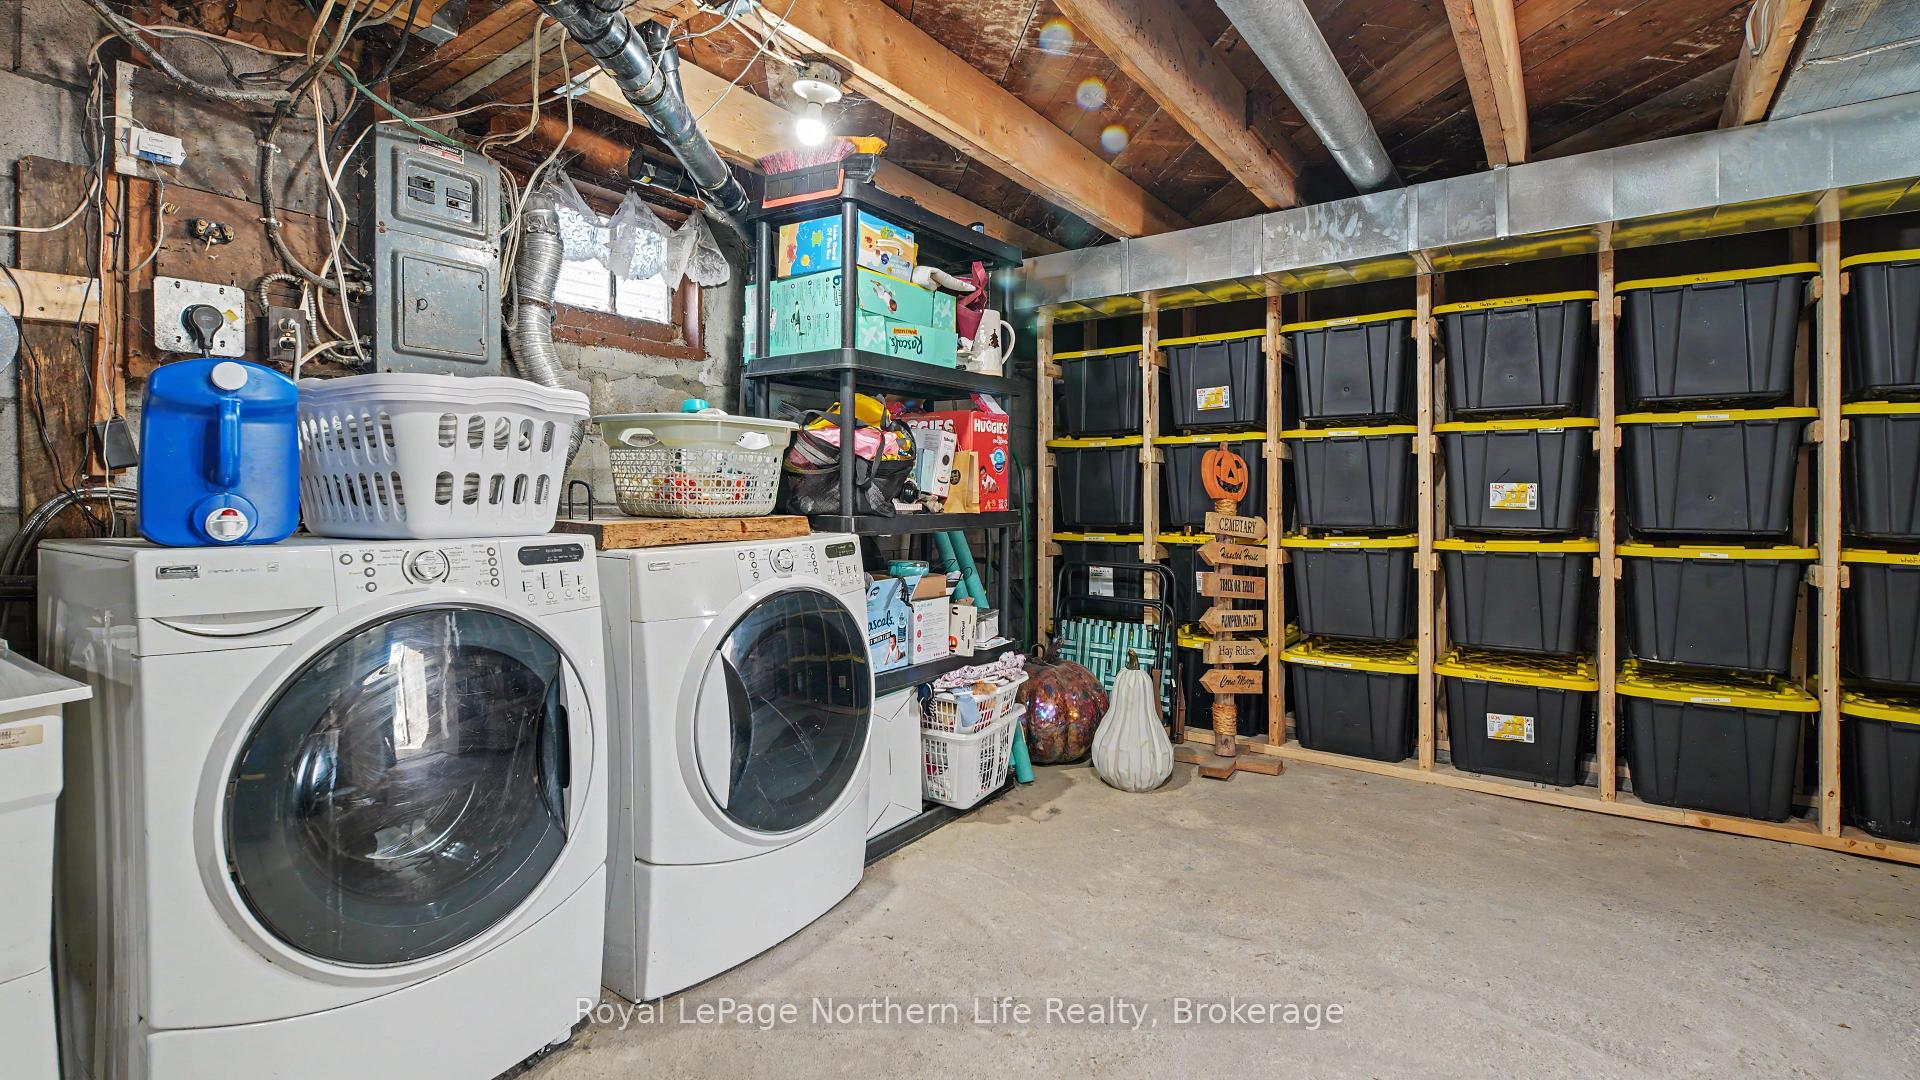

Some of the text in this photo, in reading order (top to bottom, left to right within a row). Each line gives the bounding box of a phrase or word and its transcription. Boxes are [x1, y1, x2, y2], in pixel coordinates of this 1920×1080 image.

[973, 418, 1008, 435] HUGGIES
[1220, 578, 1255, 593] TRICK OR TREAT
[1222, 614, 1257, 629] PUMPKIN PATCH
[1219, 645, 1255, 659] Hay Rides
